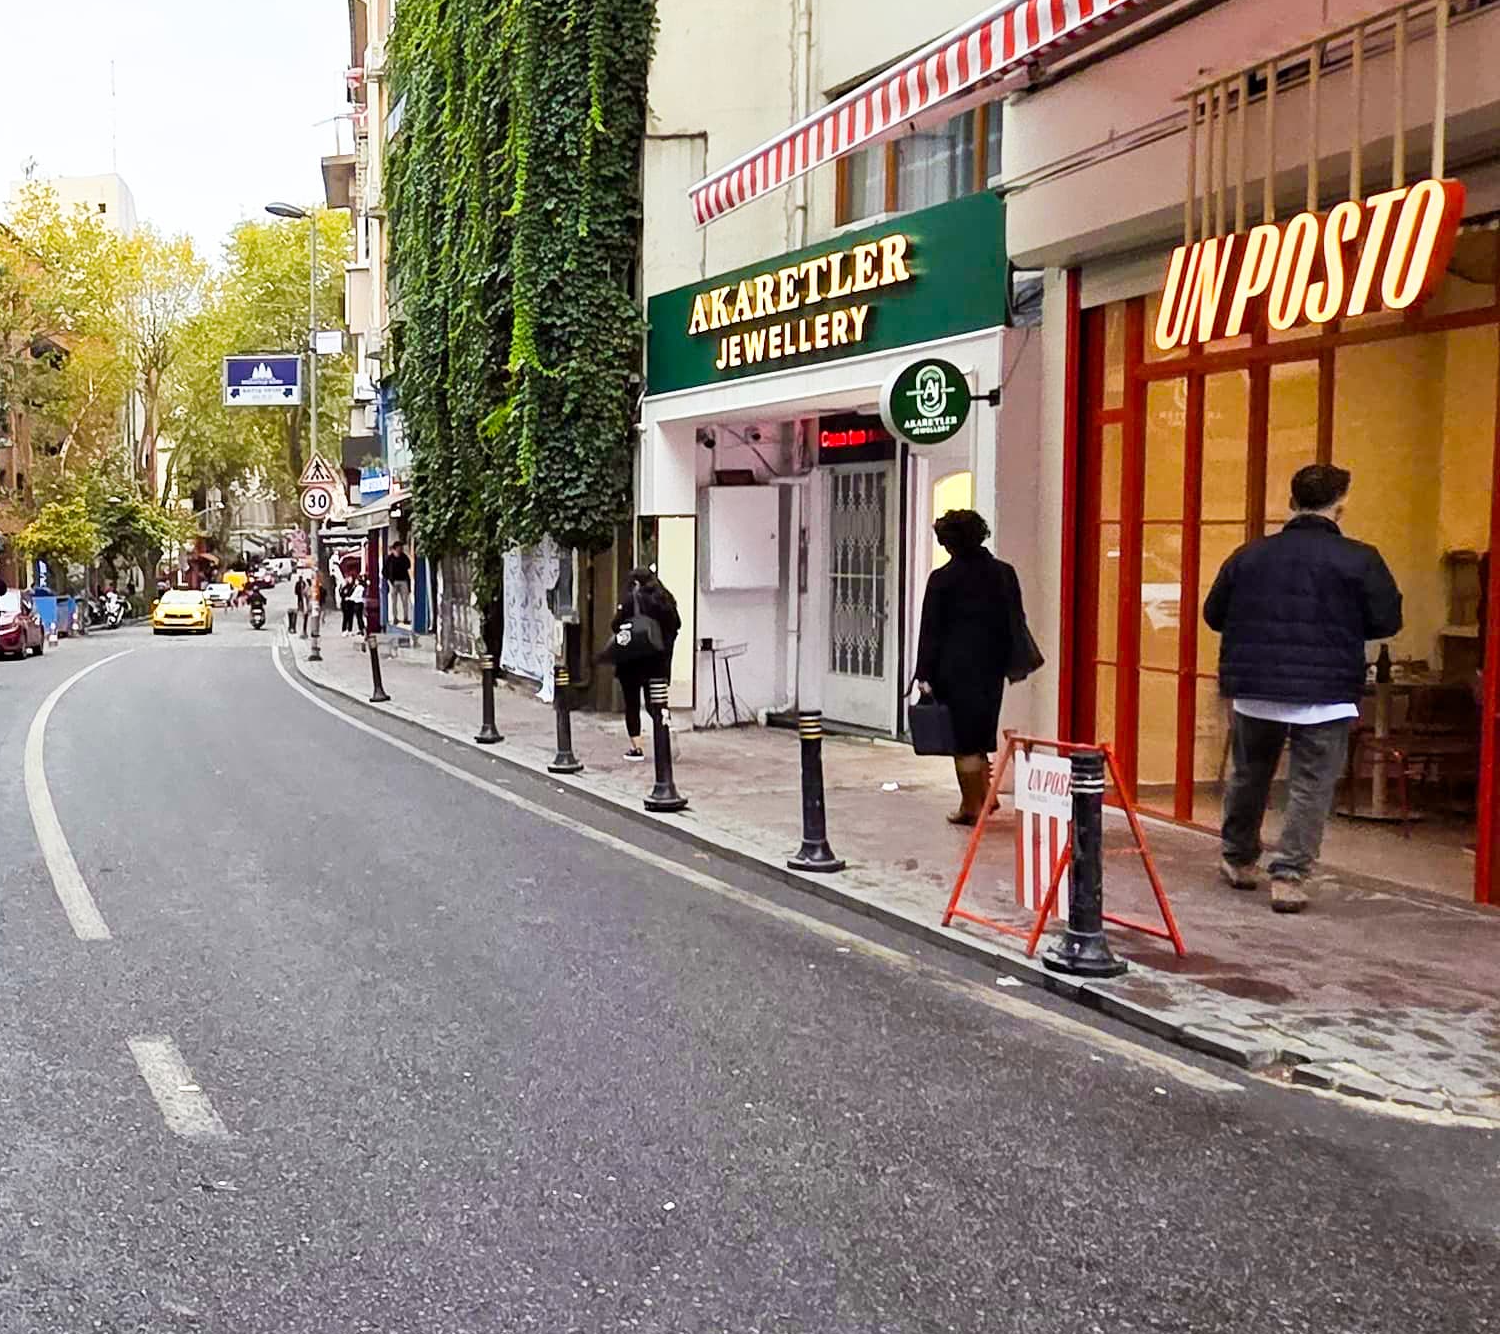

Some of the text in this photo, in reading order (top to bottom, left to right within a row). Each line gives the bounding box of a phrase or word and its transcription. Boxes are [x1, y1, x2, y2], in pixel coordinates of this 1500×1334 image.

[688, 234, 910, 335] AKARETLER
[1155, 179, 1445, 350] UN POSTO
[716, 305, 868, 370] JEWELLERY
[308, 494, 327, 508] 30
